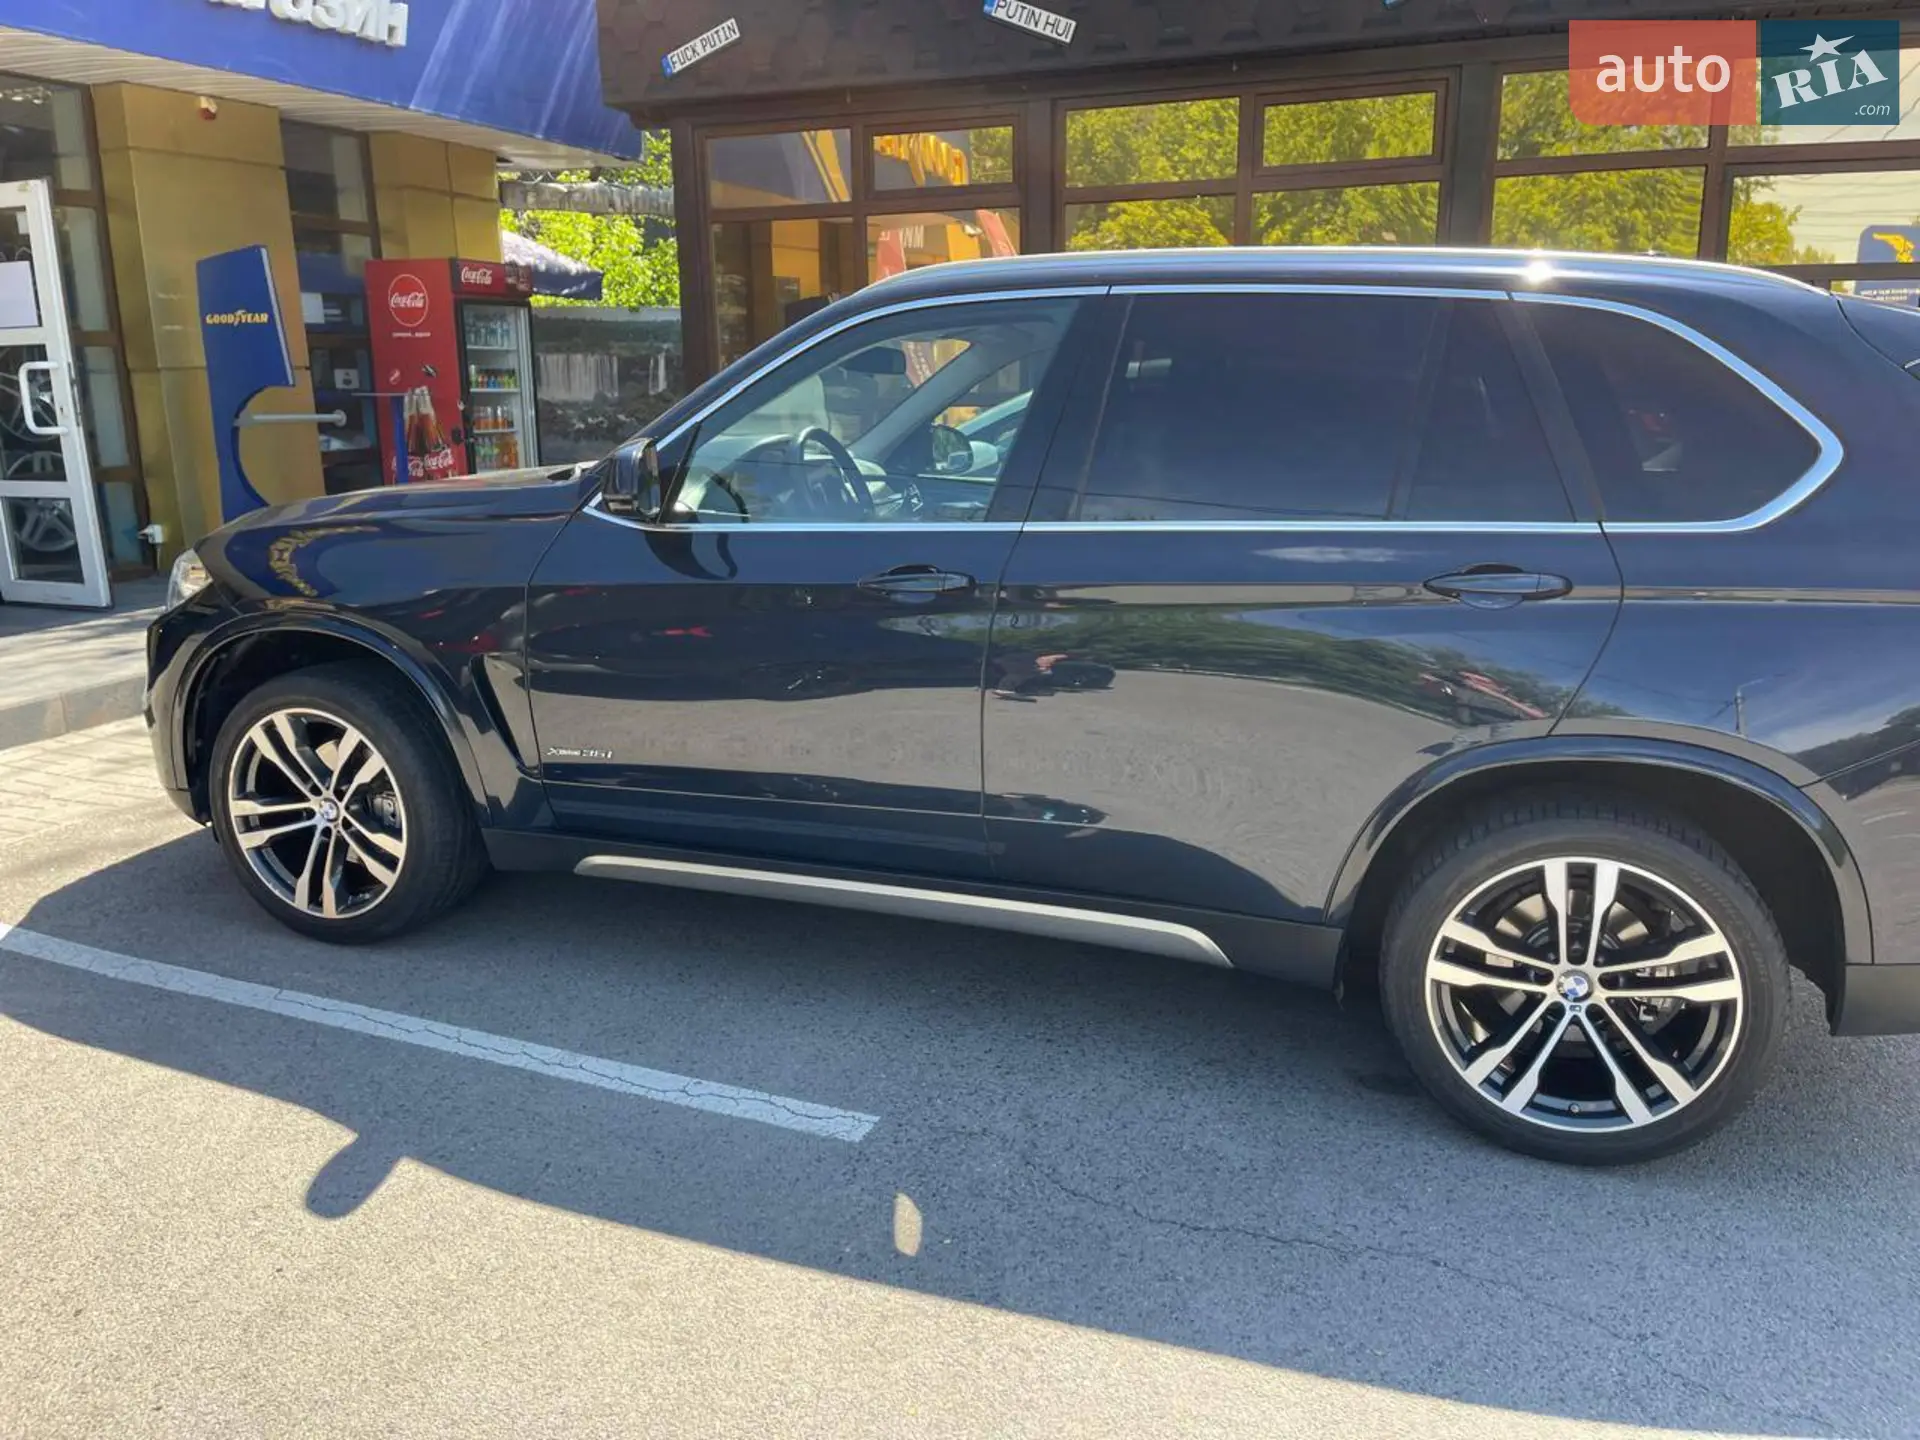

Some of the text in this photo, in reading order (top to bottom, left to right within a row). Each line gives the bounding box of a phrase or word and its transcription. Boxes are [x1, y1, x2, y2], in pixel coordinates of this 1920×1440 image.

[994, 0, 1073, 40] PUTIN HUI
[670, 21, 738, 69] FUCK PUTIN
[391, 291, 425, 309] Coca-Cola
